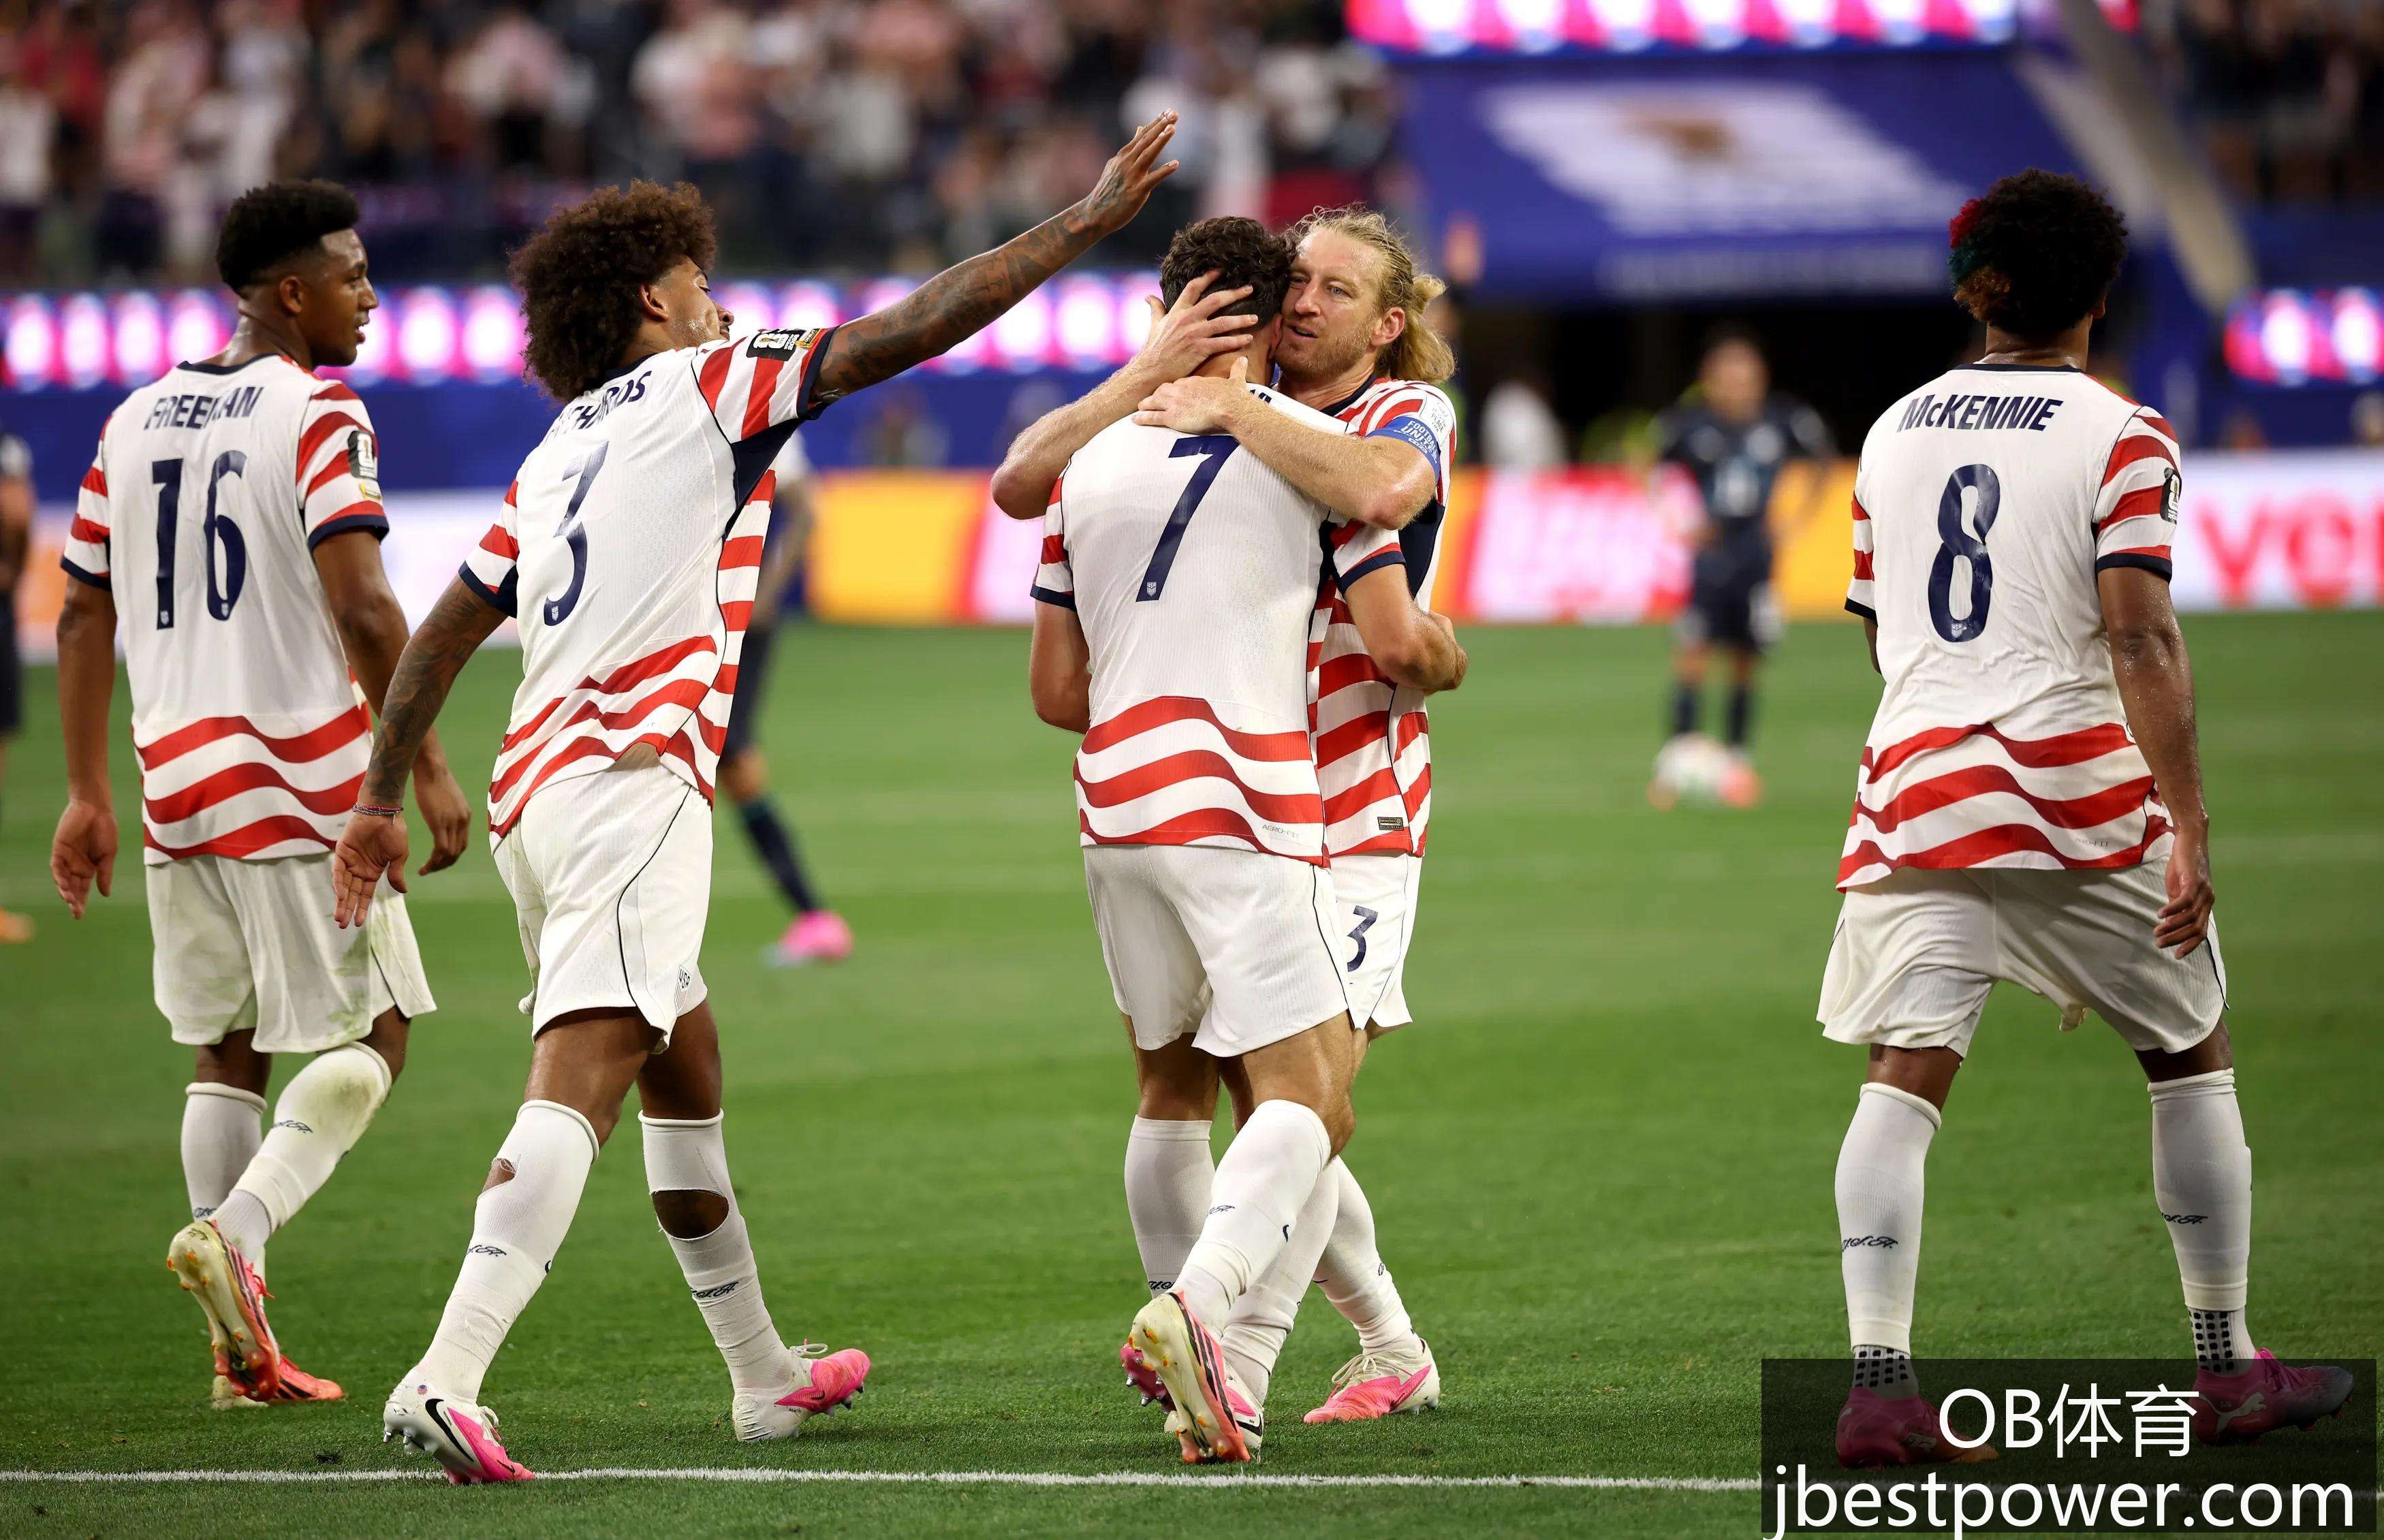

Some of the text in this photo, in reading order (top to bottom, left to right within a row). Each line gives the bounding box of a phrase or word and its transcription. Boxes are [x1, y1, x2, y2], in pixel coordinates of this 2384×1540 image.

[1898, 394, 2063, 432] McKENNIE
[151, 450, 248, 630] 16
[544, 441, 610, 626] 3
[1135, 435, 1241, 602] 7
[1928, 464, 2001, 642] 8
[679, 968, 691, 989] USA
